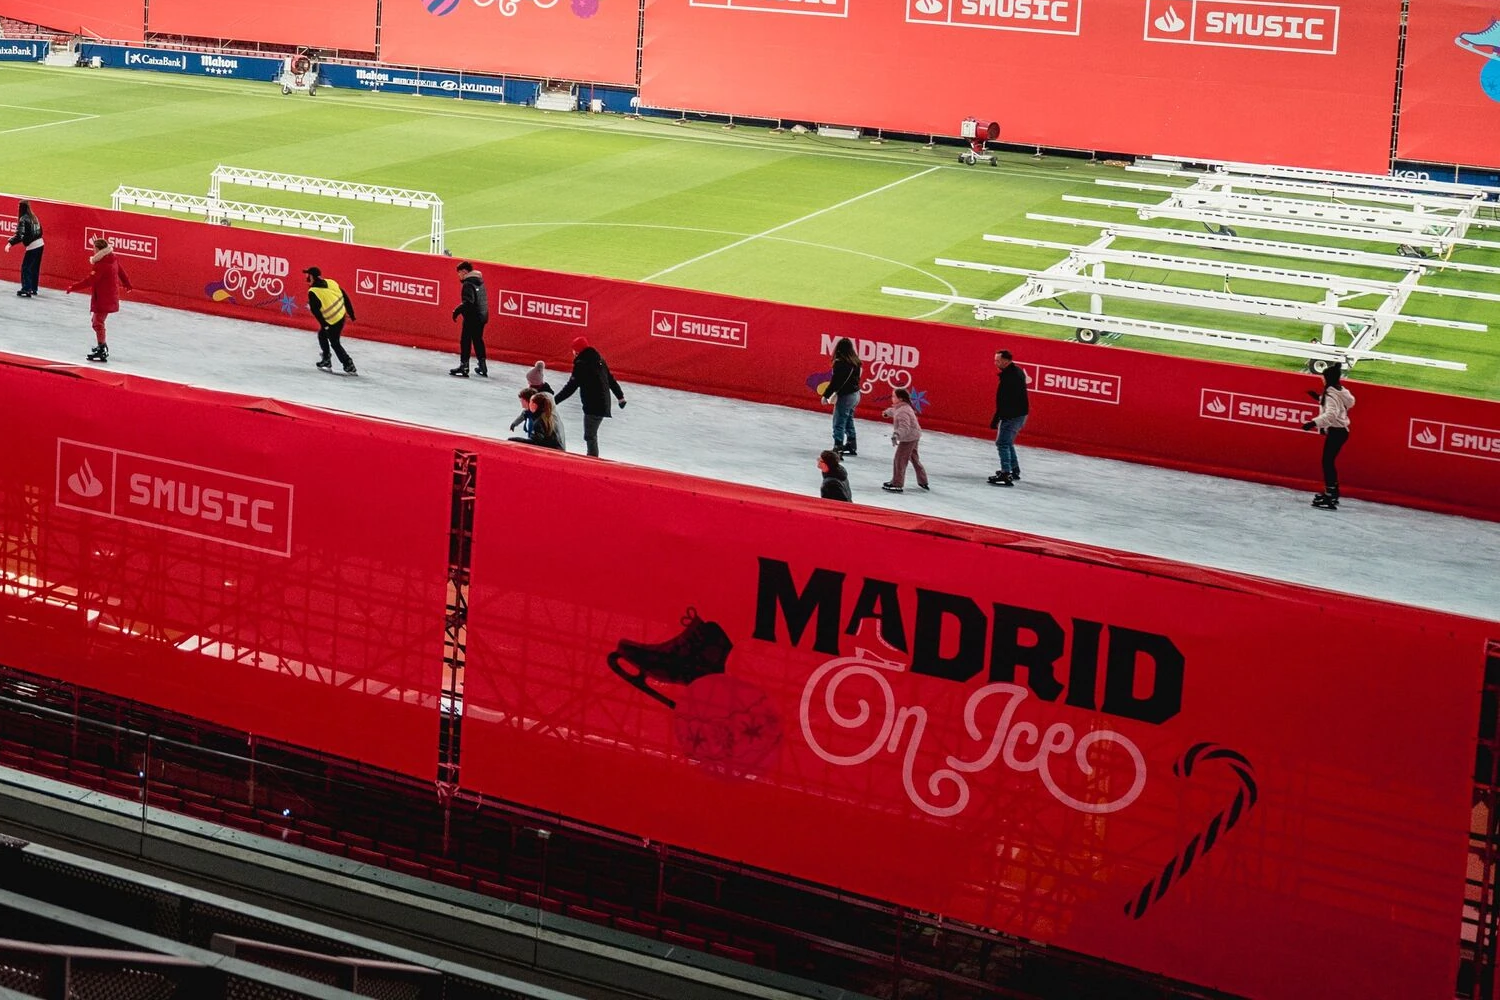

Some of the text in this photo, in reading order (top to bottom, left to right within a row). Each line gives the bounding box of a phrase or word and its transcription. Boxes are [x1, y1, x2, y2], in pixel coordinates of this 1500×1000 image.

[1205, 11, 1324, 41] SMUSIC
[141, 54, 181, 67] CaixaBank
[201, 54, 238, 68] Mahou
[356, 68, 389, 81] Mahou
[460, 83, 503, 94] HYUNDAI
[107, 236, 152, 254] SMUSIC
[214, 247, 290, 277] MADRID
[223, 266, 284, 300] On Ice
[382, 279, 434, 298] SMUSIC
[527, 300, 582, 319] SMUSIC
[681, 321, 740, 342] SMUSIC
[820, 333, 920, 369] MDRID
[1043, 373, 1112, 396] SMUSIC
[1238, 402, 1312, 425] SMUSIC
[129, 473, 275, 533] SMUSIC
[752, 556, 1187, 726] MADRID
[800, 656, 1148, 816] On Ice
